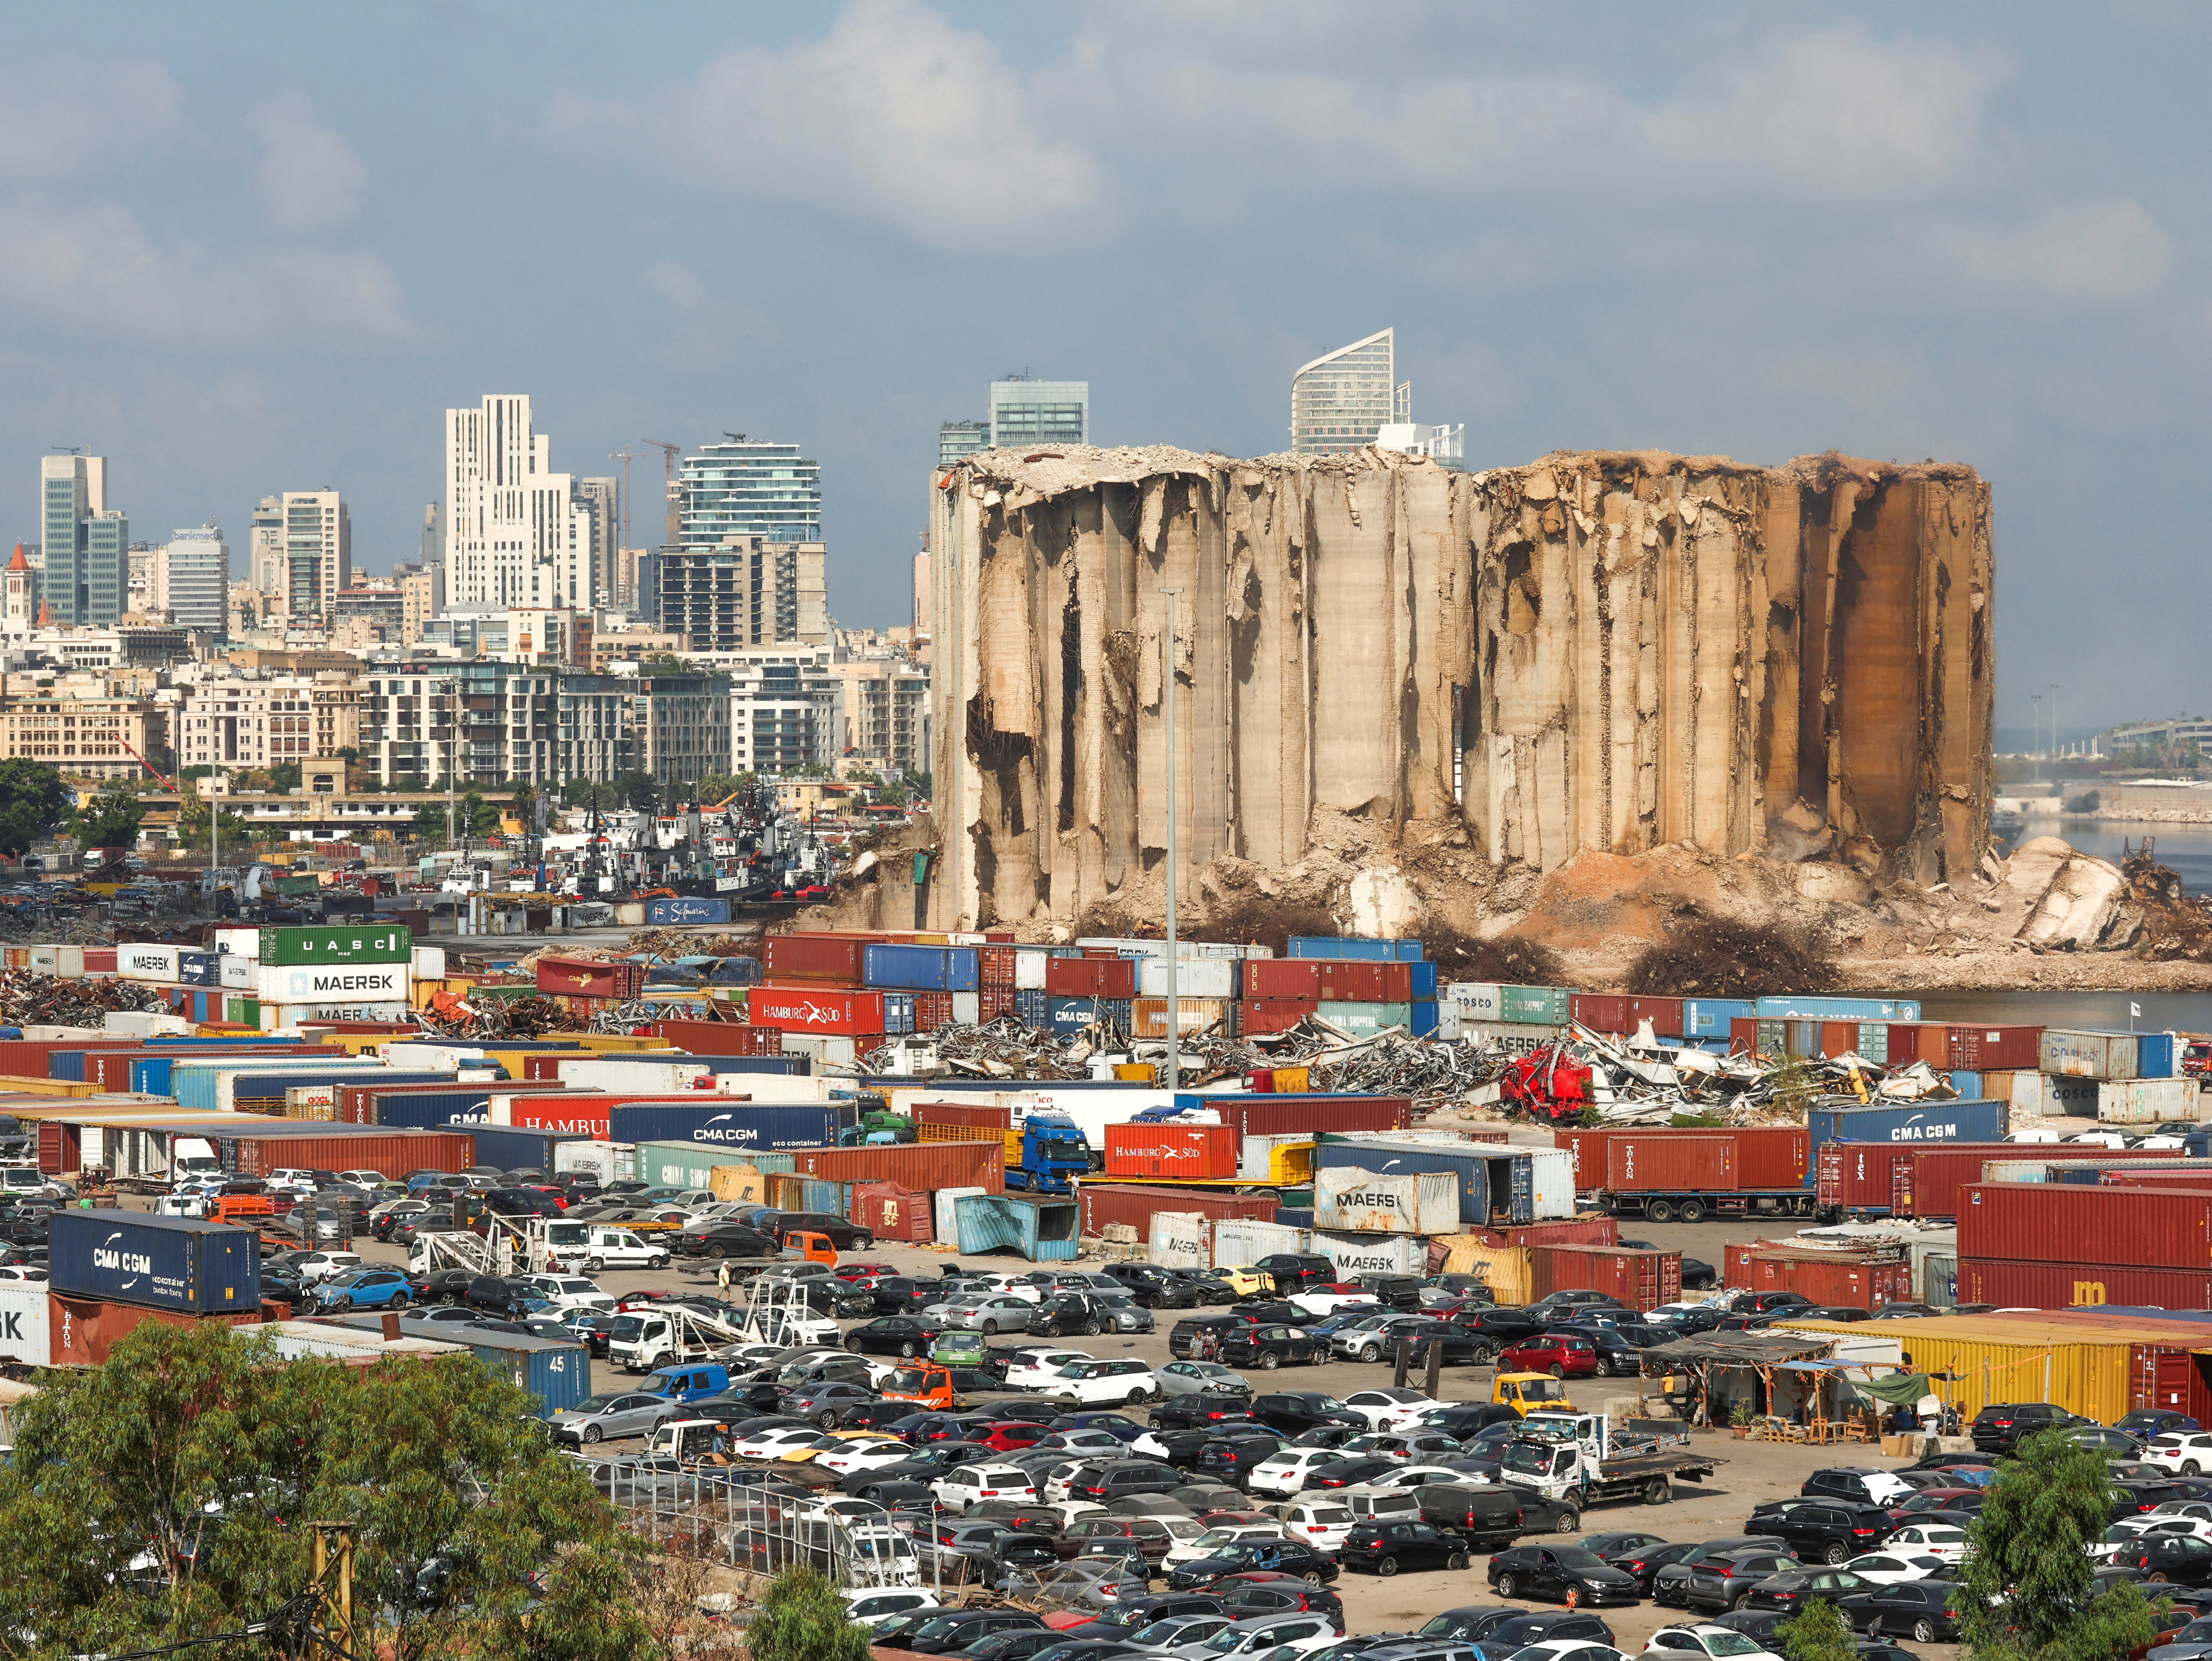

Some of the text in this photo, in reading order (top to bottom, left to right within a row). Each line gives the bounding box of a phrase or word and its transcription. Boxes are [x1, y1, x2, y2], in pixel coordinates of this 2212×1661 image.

[174, 531, 216, 540] bankmed
[670, 903, 709, 922] Safmarine
[133, 956, 169, 970] MAERSK
[229, 968, 247, 976] MAERSK
[314, 975, 394, 990] MAERSK
[319, 1009, 362, 1021] MAER
[763, 1004, 840, 1022] HAMBURG SÜD
[1055, 1011, 1094, 1023] CMA CGM
[1349, 1016, 1375, 1028] SHIPPING
[1491, 1036, 1547, 1053] AERSK
[2052, 1088, 2098, 1100] COSCO
[450, 1114, 488, 1124] CMA
[525, 1118, 610, 1134] HAMBU
[694, 1129, 757, 1140] CMA CGM
[1891, 1124, 1956, 1141] CMA CGM
[1116, 1147, 1200, 1158] HAMBURG SÜD
[573, 1160, 602, 1171] MAERSK
[662, 1165, 684, 1186] CHINA
[689, 1168, 711, 1189] SHIPP
[1169, 1238, 1198, 1254] MAERS
[94, 1248, 150, 1274] CMA CGM
[1337, 1254, 1395, 1271] MAERSK
[0, 1311, 24, 1341] K
[549, 1356, 564, 1372] 45
[515, 1371, 522, 1387] 45
[1092, 1524, 1099, 1536] R
